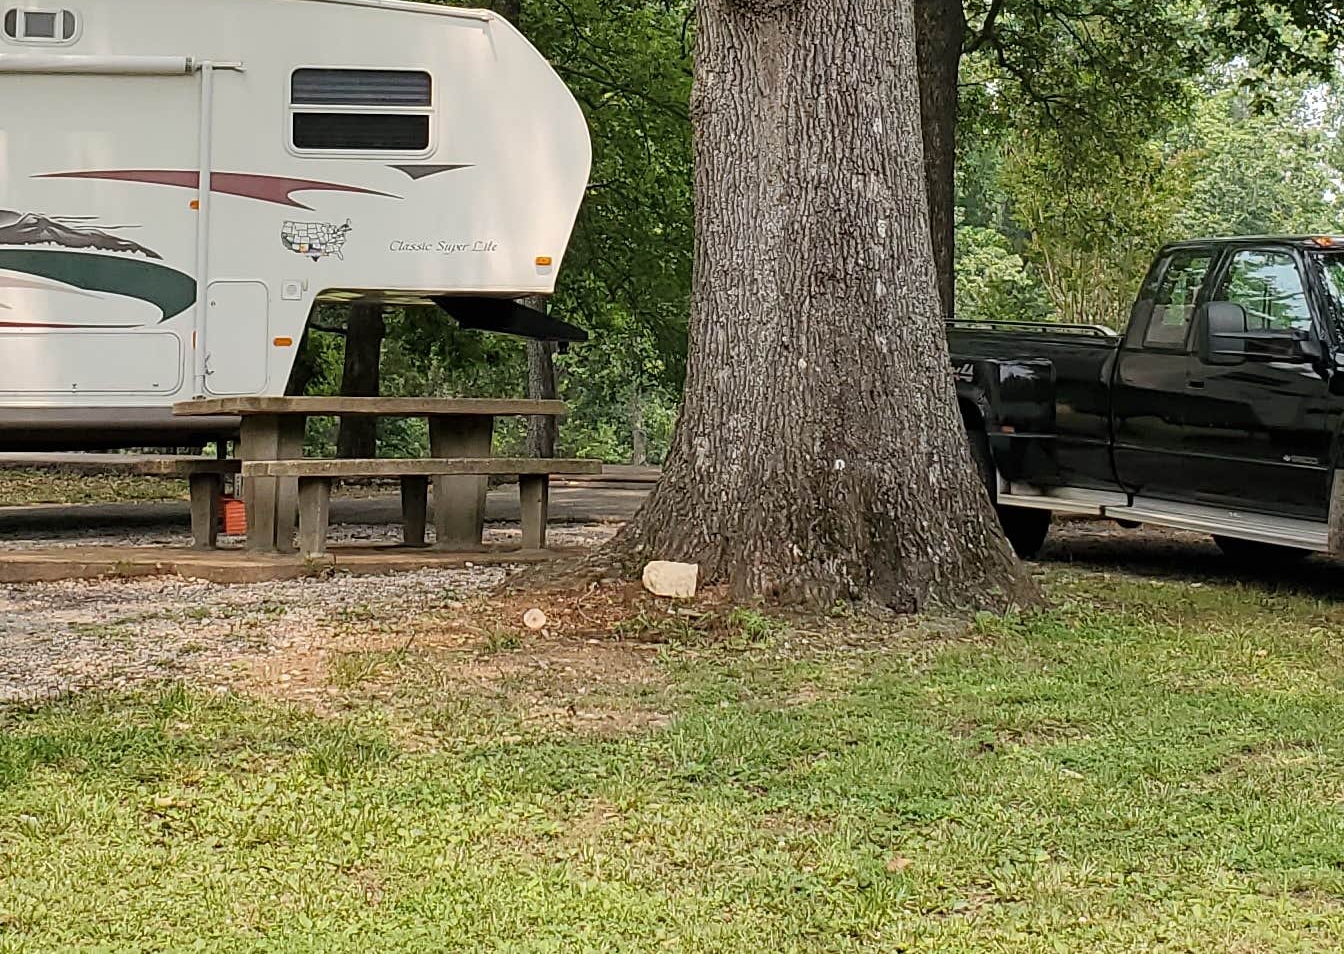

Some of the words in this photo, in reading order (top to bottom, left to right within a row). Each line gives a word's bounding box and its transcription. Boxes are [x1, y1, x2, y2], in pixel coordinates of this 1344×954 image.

[389, 240, 432, 252] Classic
[435, 240, 470, 255] Super
[471, 240, 498, 252] Lite
